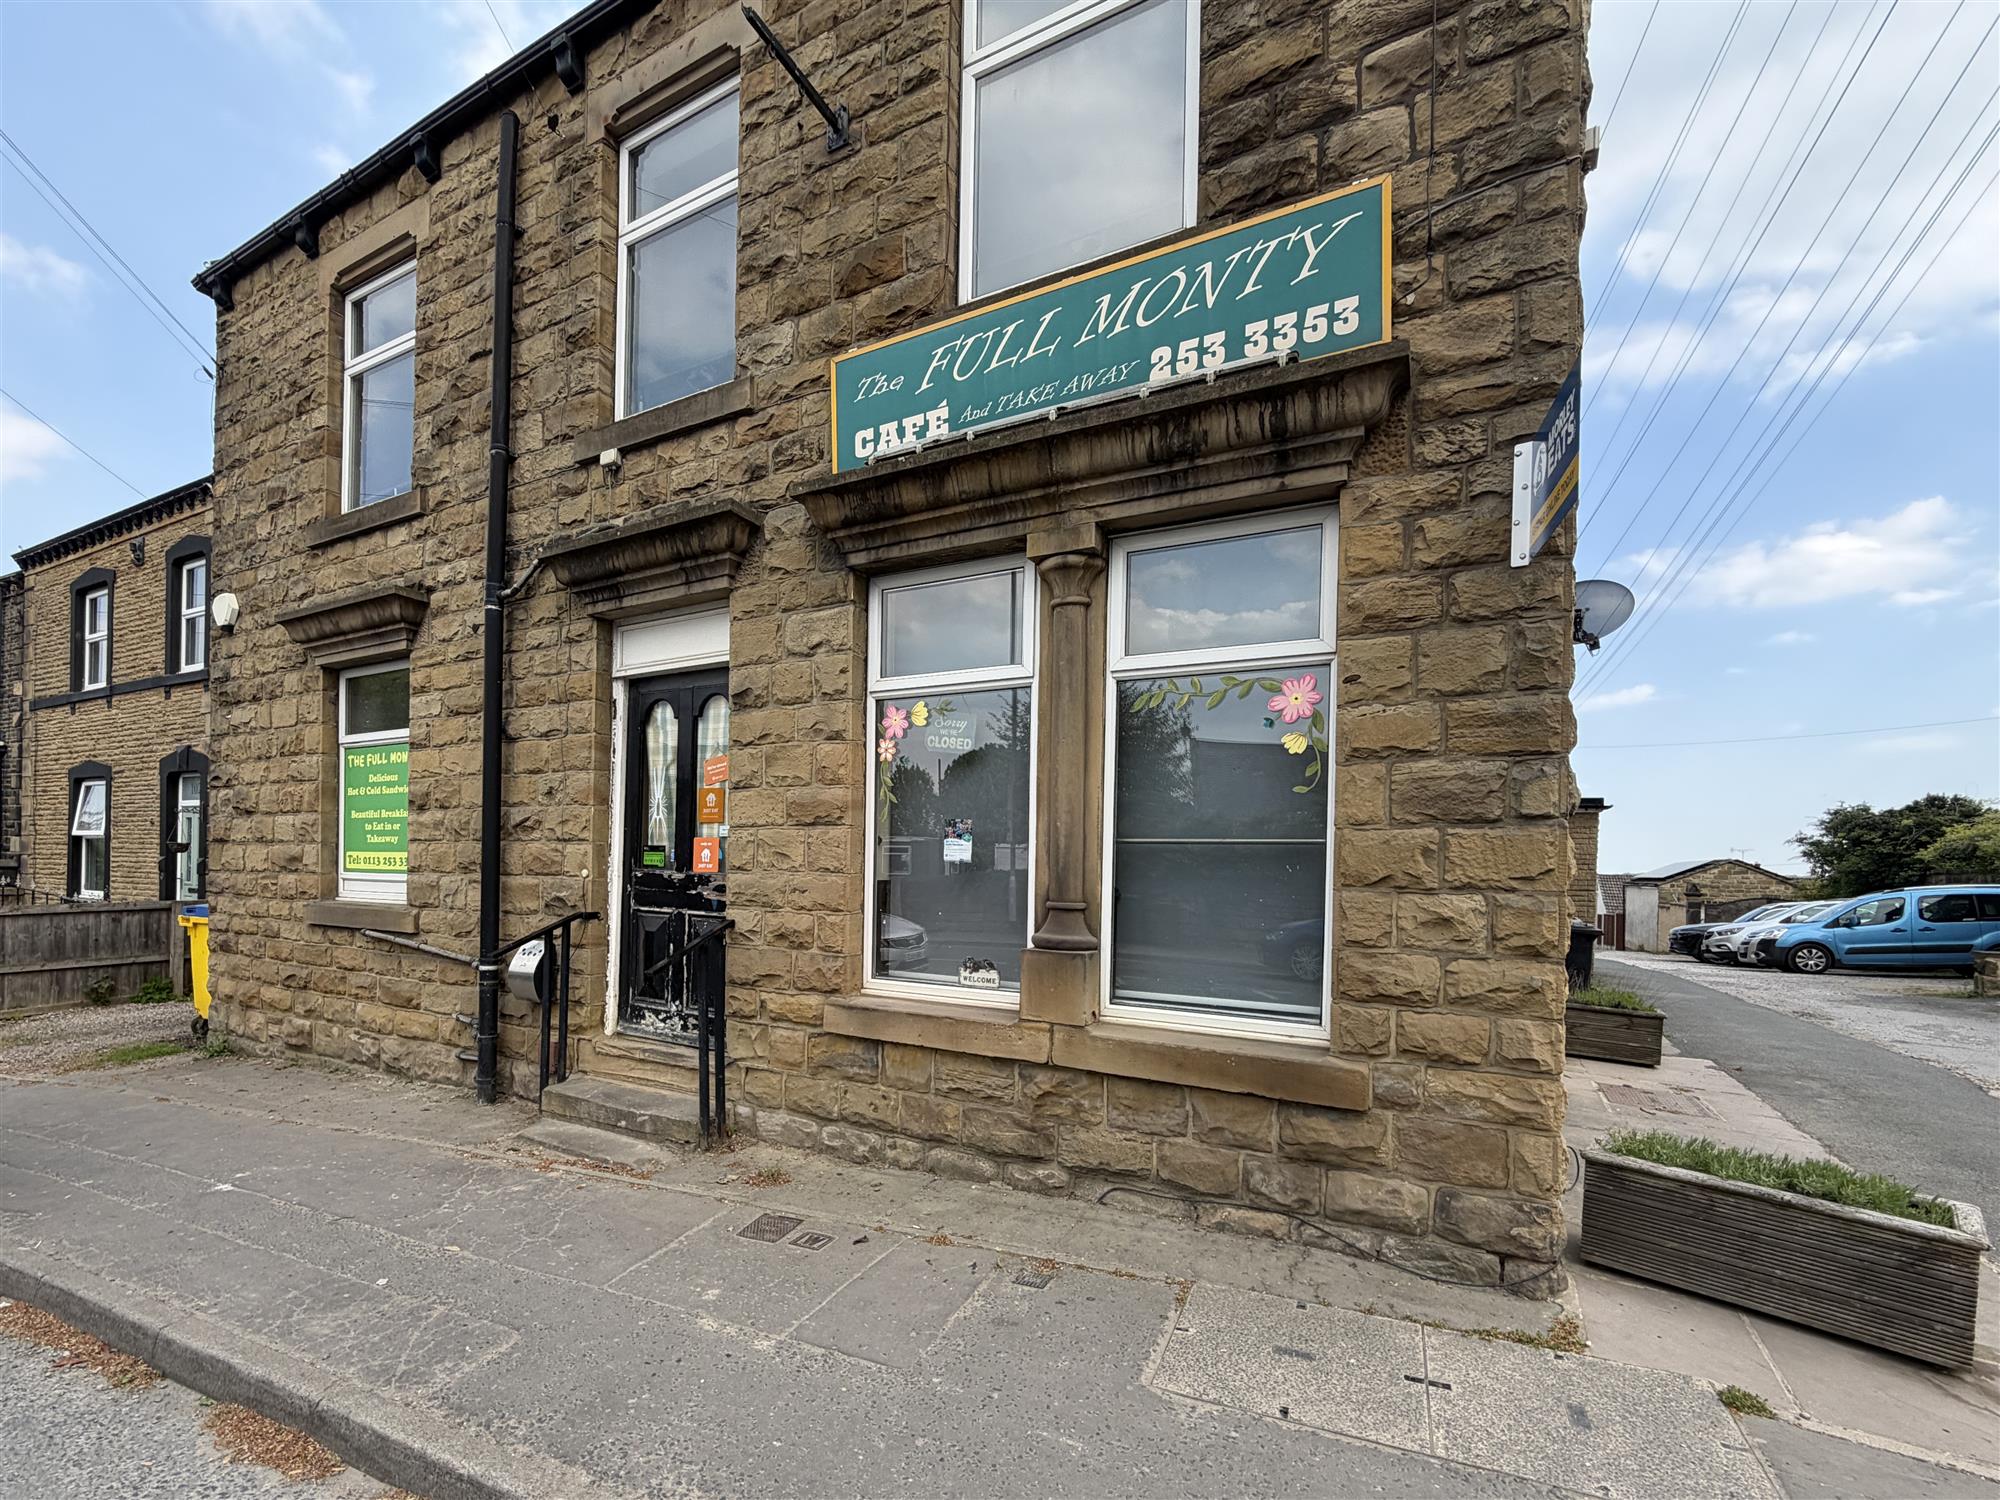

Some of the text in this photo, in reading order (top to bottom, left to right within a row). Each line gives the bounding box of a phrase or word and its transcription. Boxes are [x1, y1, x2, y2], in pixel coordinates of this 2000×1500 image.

[853, 211, 1363, 403] The FULL MONTY
[854, 294, 1360, 458] CAFÉ And TAKE AWAY 253 3353
[1548, 387, 1576, 451] MORLEY
[1547, 411, 1576, 478] EATS
[934, 716, 968, 733] Sorry
[927, 735, 972, 750] CLOSED
[347, 754, 365, 768] THE
[366, 752, 388, 767] FULL
[368, 773, 399, 783] Delicious
[347, 786, 359, 796] Hot
[359, 786, 366, 796] &
[366, 785, 382, 795] Cold
[351, 809, 380, 819] Beautiful
[365, 823, 372, 831] to
[373, 821, 384, 830] Eat
[384, 821, 392, 830] in
[366, 834, 399, 845] Takeaway
[347, 855, 361, 865] Tel:
[362, 856, 381, 867] 0113
[382, 856, 397, 867] 253
[963, 975, 997, 985] WELCOME
